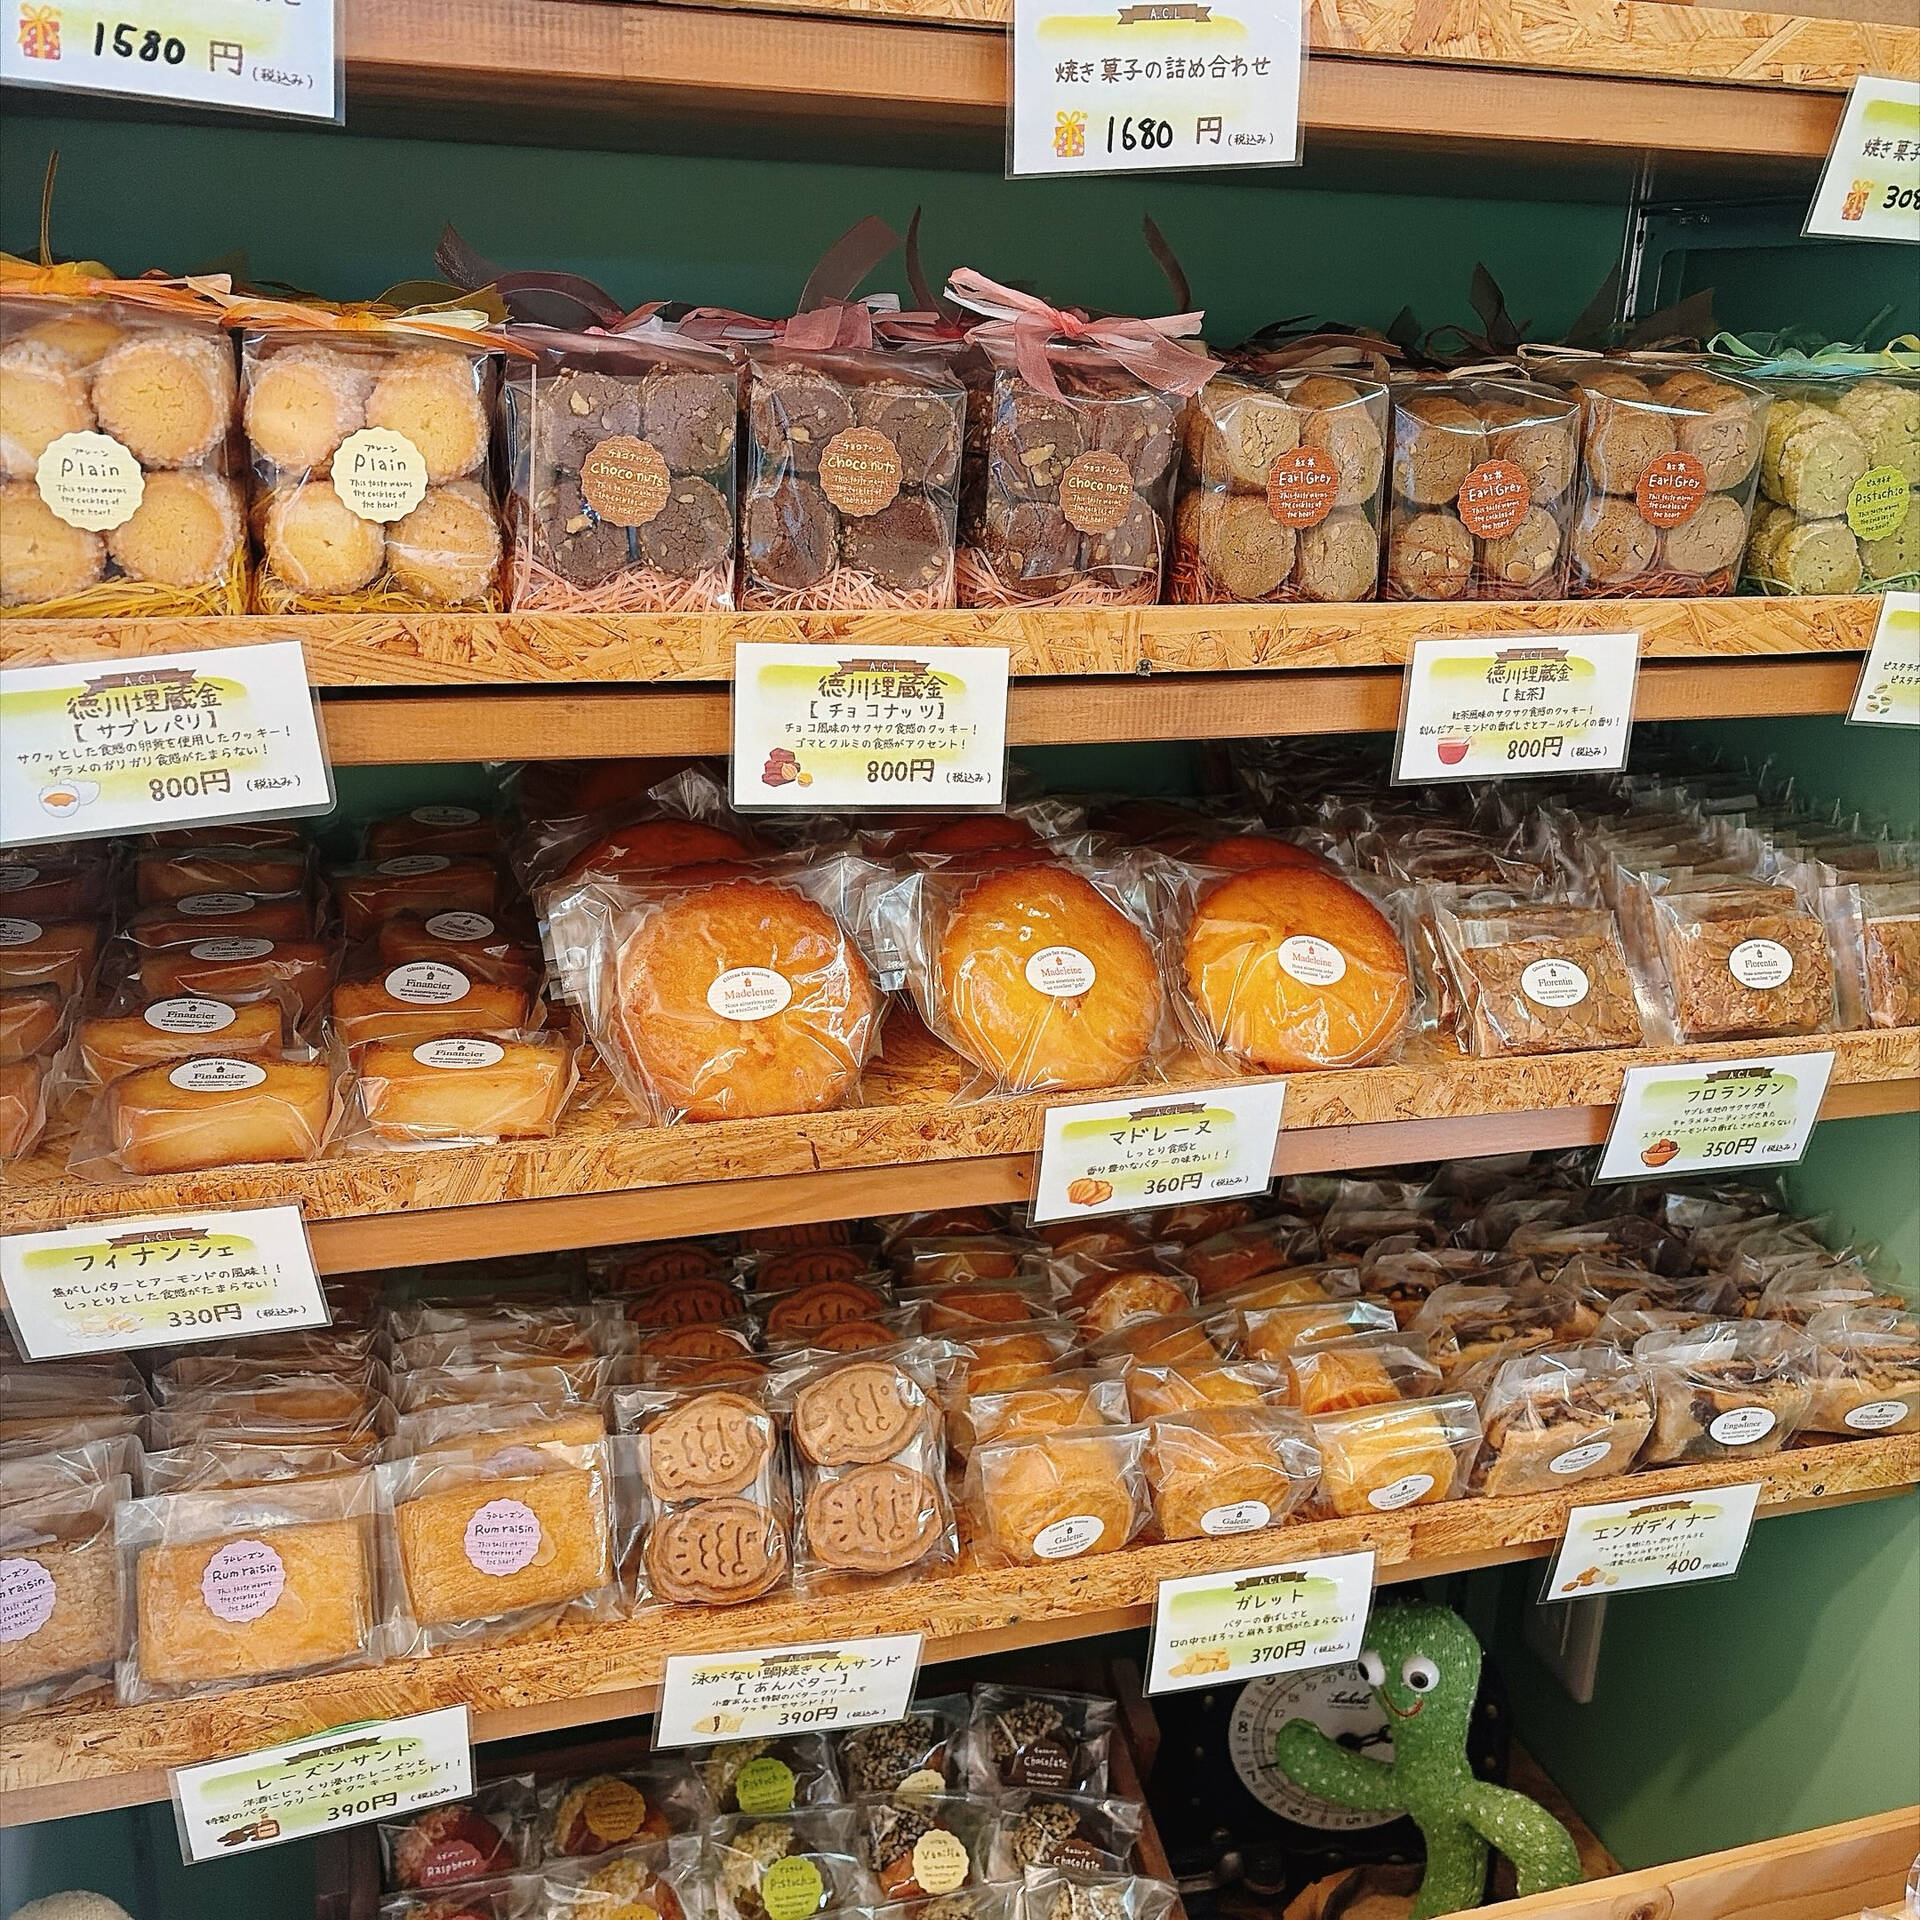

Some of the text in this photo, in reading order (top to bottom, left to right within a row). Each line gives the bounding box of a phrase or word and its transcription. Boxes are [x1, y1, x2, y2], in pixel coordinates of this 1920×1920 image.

[94, 22, 186, 65] 1580
[209, 40, 243, 75] 円
[1055, 55, 1271, 83] 焼き菓子の詰め合わせ
[1107, 117, 1173, 153] 1680
[1196, 117, 1222, 144] 円
[62, 458, 120, 477] Plain
[355, 453, 406, 472] Plain
[828, 456, 896, 473] Choco nuts
[591, 463, 664, 487] Choco nuts
[1279, 471, 1331, 486] Earl Grey
[1649, 474, 1700, 488] Earl Grey
[1068, 477, 1129, 495] Choco nuts
[1469, 484, 1521, 502] Earl Grey
[1855, 488, 1903, 506] Pistachio
[1486, 664, 1573, 684] 徳川埋蔵金
[818, 675, 948, 700] 徳川埋蔵金
[66, 682, 224, 720] 徳川埋蔵金
[1507, 736, 1563, 760] 800円
[867, 758, 934, 782] 800円
[149, 769, 231, 801] 800円
[1292, 952, 1332, 966] Madeleine
[1745, 959, 1777, 968] Florentin
[1041, 967, 1082, 977] Madeleine
[405, 979, 452, 990] Financier
[1538, 977, 1573, 987] Florentin
[725, 988, 774, 1000] Madeleine
[166, 1011, 216, 1019] Financier
[435, 1049, 484, 1057] Financier
[1688, 1082, 1784, 1103] フロランタン
[1110, 1120, 1213, 1144] マドレーヌ
[1126, 1143, 1196, 1159] しっとり食感と
[1702, 1137, 1757, 1158] 350円
[1144, 1172, 1202, 1195] 360円
[74, 1242, 234, 1272] フィナンシェ
[169, 1303, 242, 1328] 330円
[475, 1525, 533, 1536] Rum raisin
[1592, 1513, 1717, 1541] エンガディナー
[213, 1565, 276, 1582] Rum raisin
[1667, 1557, 1701, 1575] 400
[8, 1579, 45, 1595] raisin
[1236, 1589, 1304, 1611] ガレット
[1250, 1640, 1306, 1664] 370円
[778, 1707, 838, 1726] 390円
[256, 1742, 417, 1790] レーズンサンド
[1024, 1756, 1068, 1769] Chocolate
[327, 1792, 397, 1821] 390円
[921, 1848, 960, 1860] Vanilla
[426, 1858, 478, 1877] Raspberry
